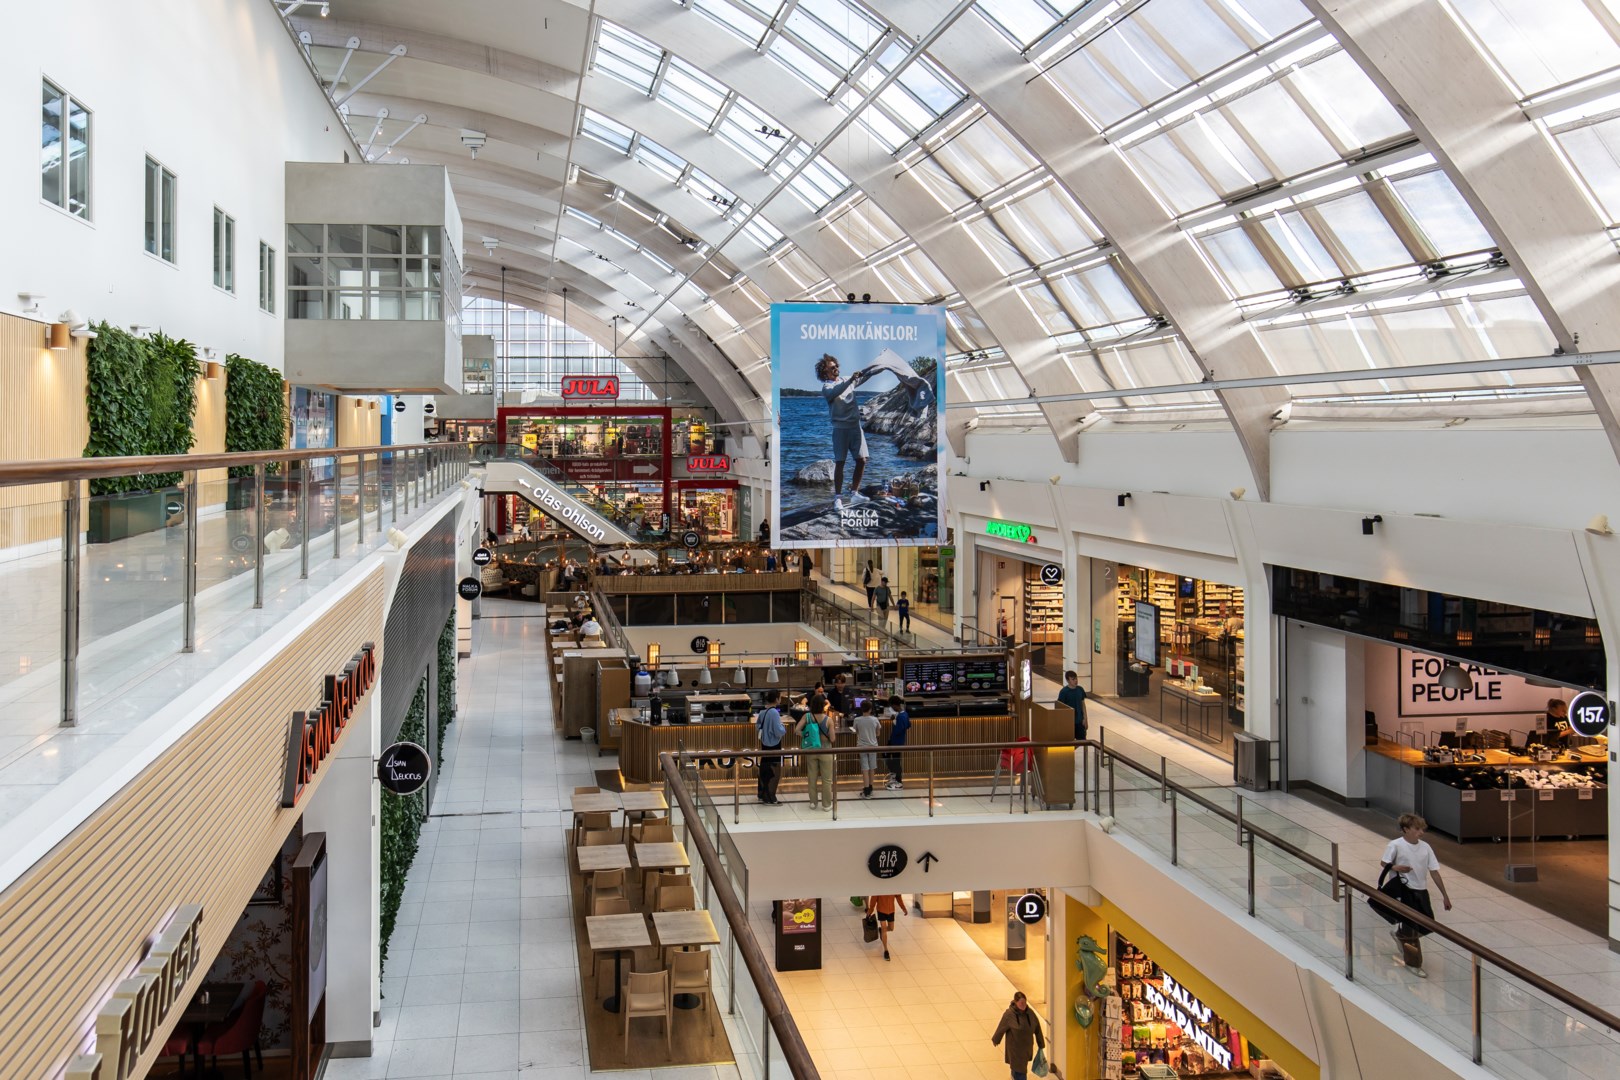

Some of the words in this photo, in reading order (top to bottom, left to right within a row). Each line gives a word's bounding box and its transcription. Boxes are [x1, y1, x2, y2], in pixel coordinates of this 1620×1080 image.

[800, 321, 918, 341] SOMMARKÄNSLOR!
[563, 379, 617, 395] JULA
[689, 457, 728, 469] JULA
[533, 487, 562, 511] clas
[562, 507, 605, 541] ohlson
[841, 509, 879, 518] NACKA
[841, 518, 879, 527] FORUM
[1412, 681, 1502, 702] PEOPLE
[285, 702, 332, 808] ASIAN
[385, 753, 407, 768] ASIAN
[1025, 901, 1038, 914] D
[96, 904, 204, 1080] HOUSE
[1162, 971, 1213, 1023] KALAS
[1145, 982, 1233, 1070] KOMPANIET
